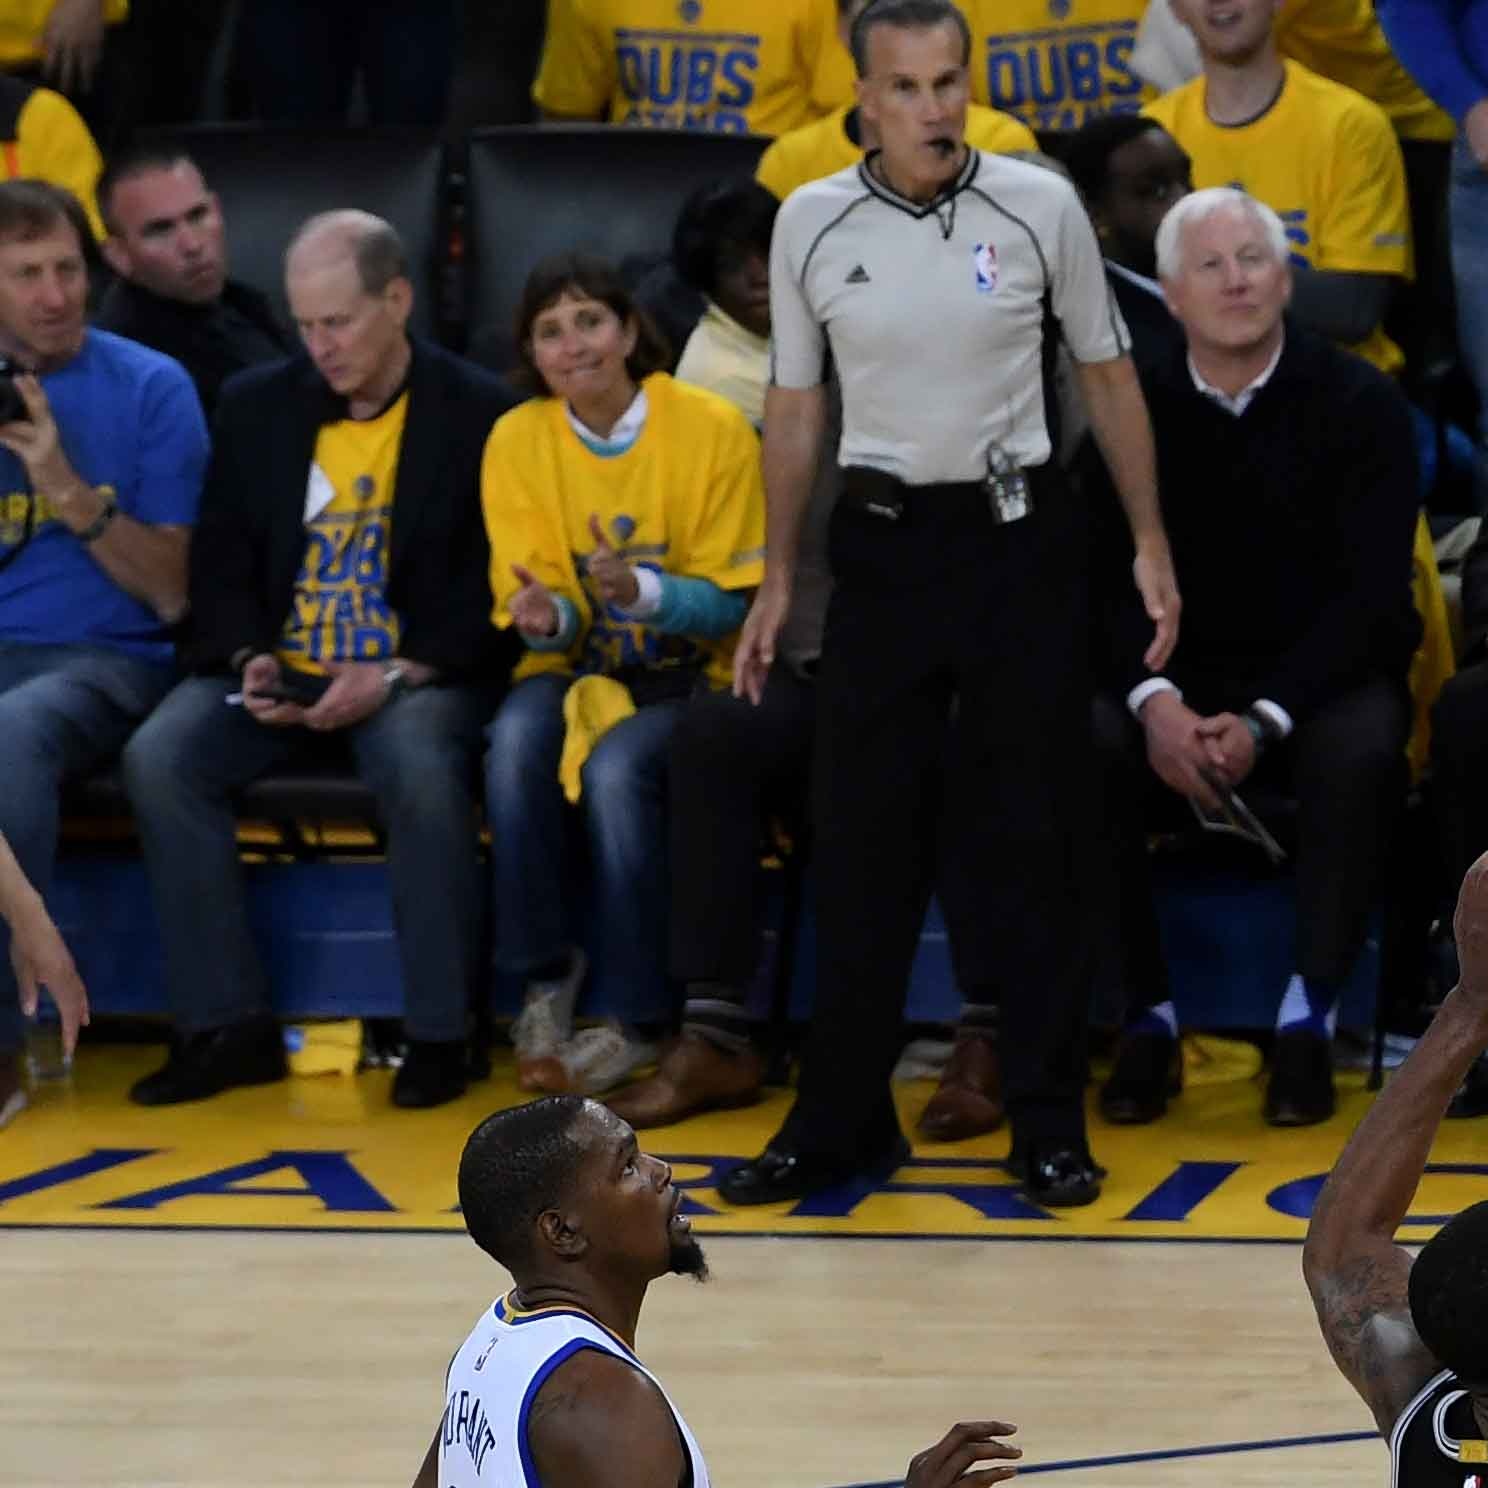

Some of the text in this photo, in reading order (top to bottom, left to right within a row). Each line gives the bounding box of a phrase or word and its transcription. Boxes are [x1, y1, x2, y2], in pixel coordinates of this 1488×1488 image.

[614, 44, 759, 108] DUBS
[988, 36, 1143, 107] DUBS
[297, 523, 385, 585] DUB
